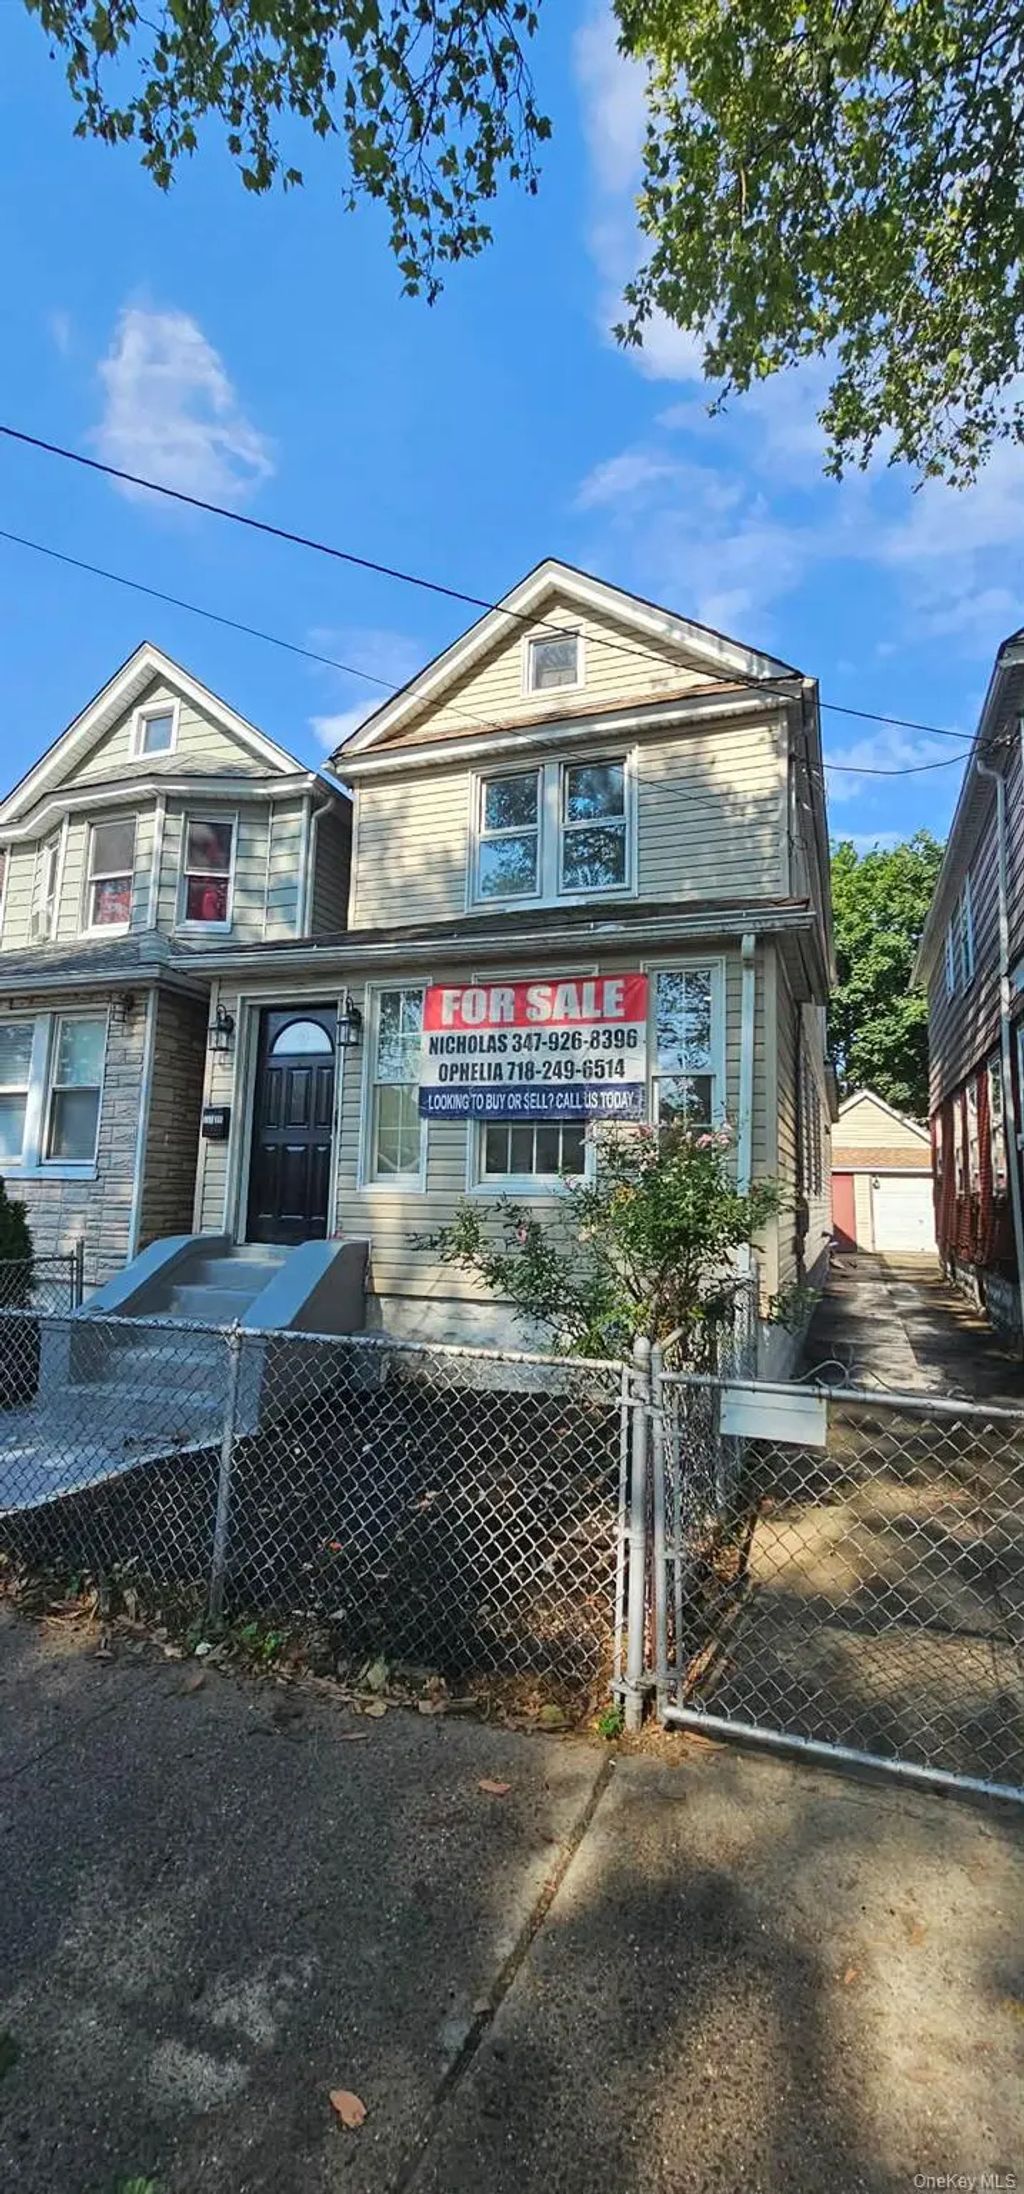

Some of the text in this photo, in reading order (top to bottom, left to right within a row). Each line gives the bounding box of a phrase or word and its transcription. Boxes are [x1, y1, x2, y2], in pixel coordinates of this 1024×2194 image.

[441, 979, 625, 1025] FOR SALE
[429, 1028, 638, 1055] NICHOLAS 347-926-8396
[438, 1058, 626, 1082] OPHELIA 718-249-6514
[428, 1094, 469, 1110] LOOKING
[471, 1094, 484, 1110] TO
[485, 1094, 507, 1110] BUY
[508, 1093, 521, 1109] OR
[523, 1092, 554, 1110] SELL?
[556, 1092, 583, 1109] CALL
[584, 1092, 598, 1108] US
